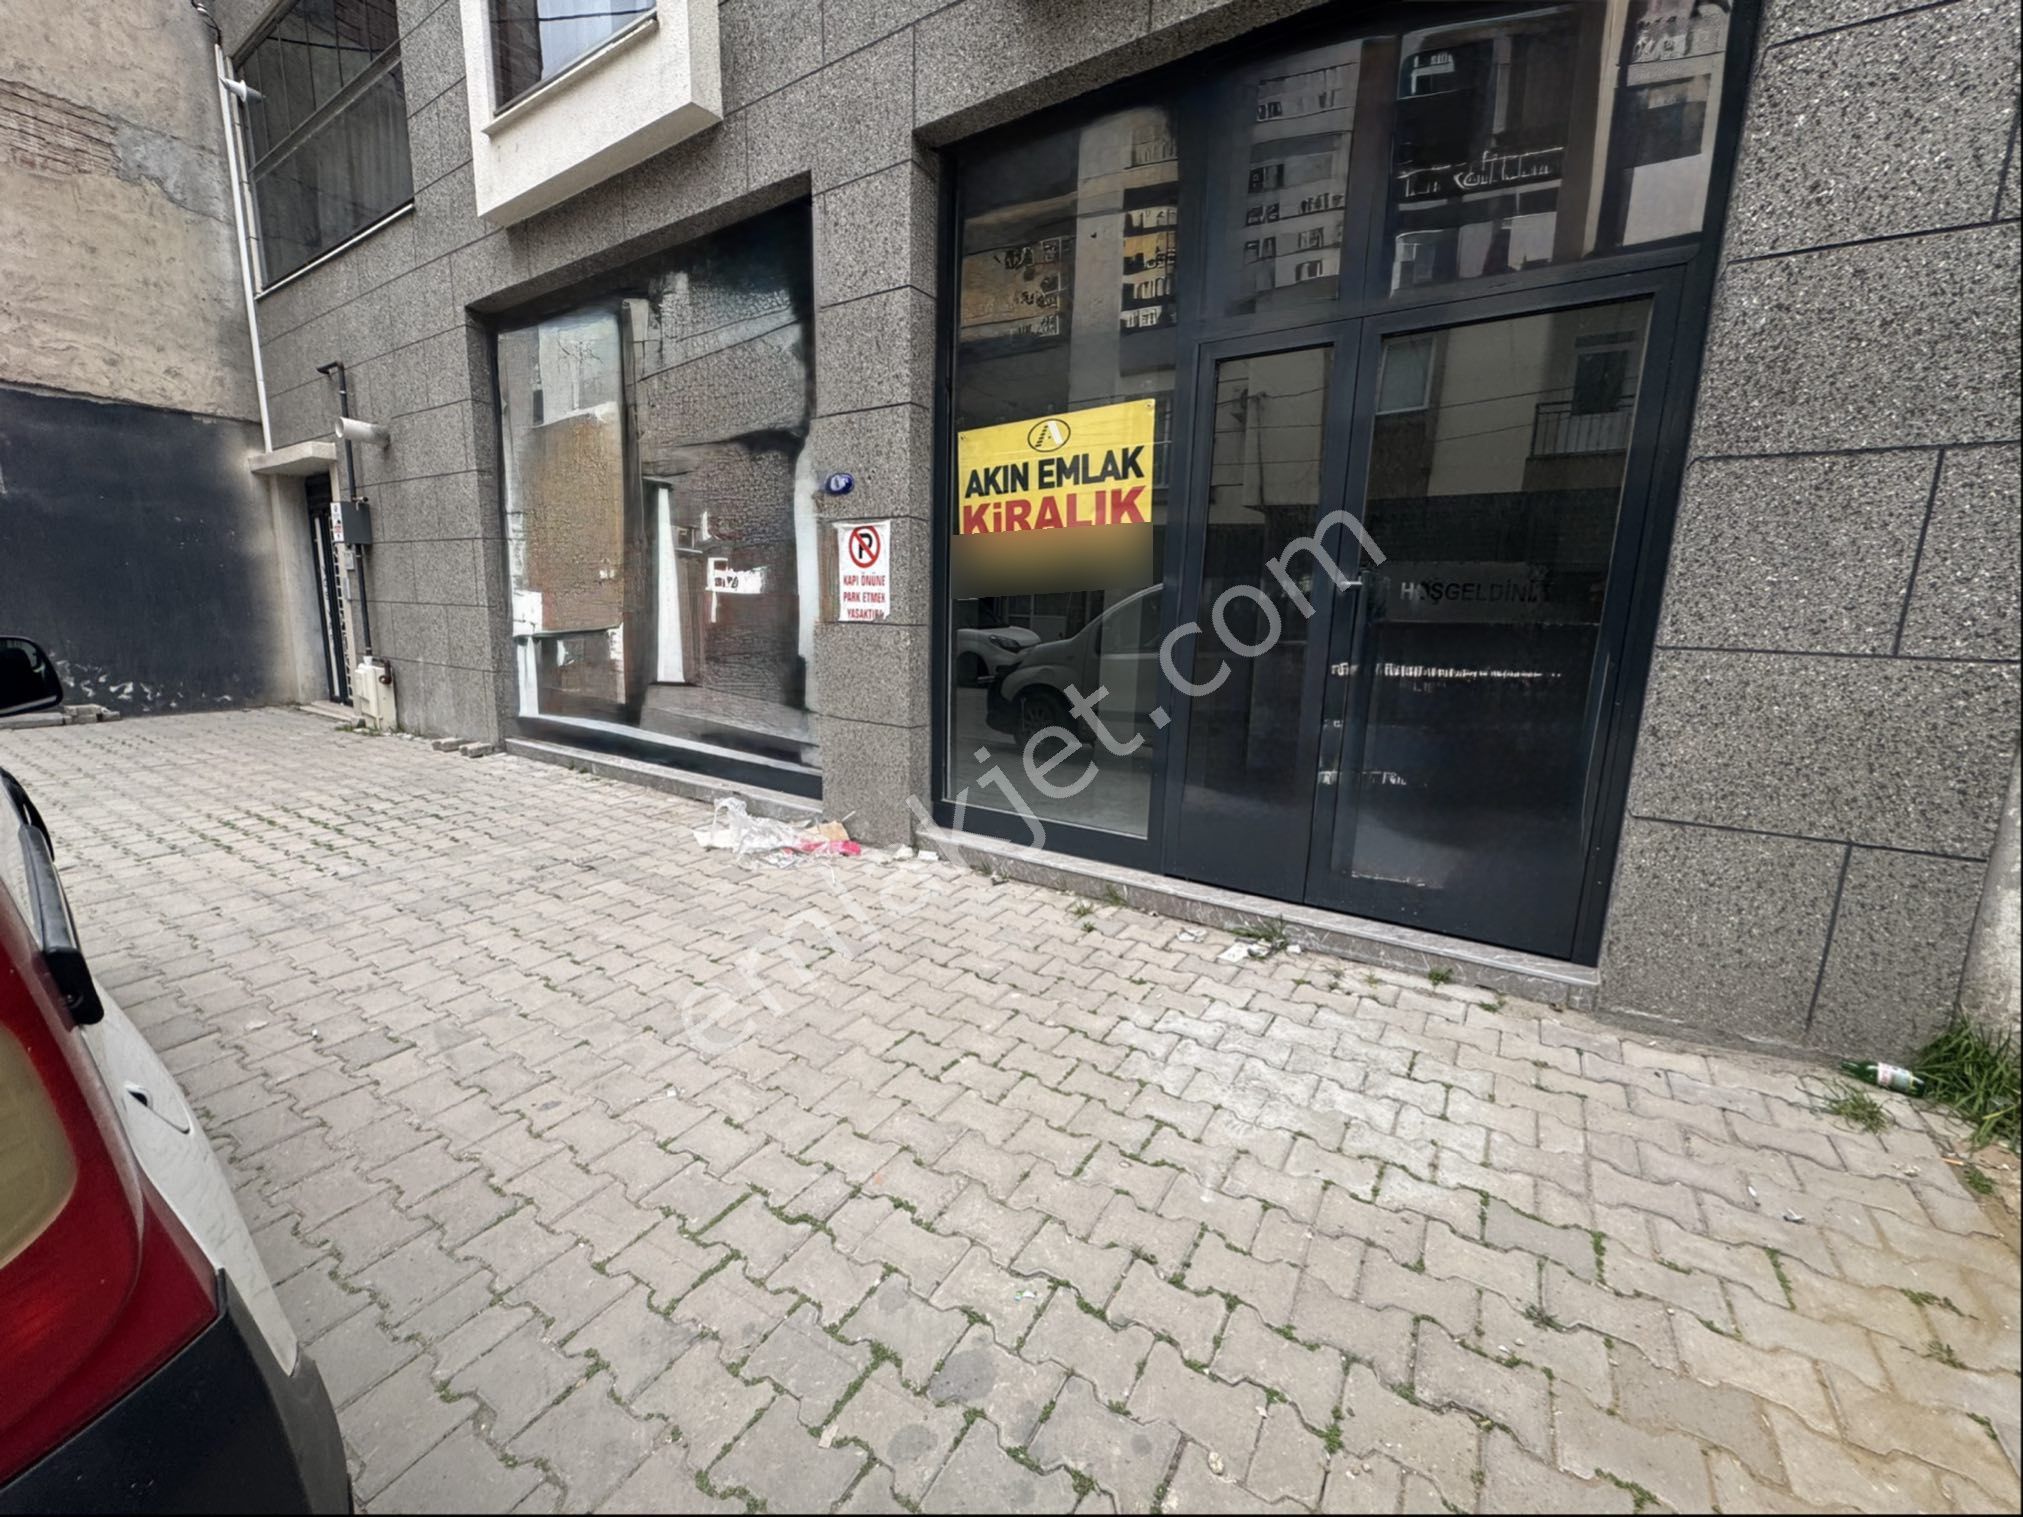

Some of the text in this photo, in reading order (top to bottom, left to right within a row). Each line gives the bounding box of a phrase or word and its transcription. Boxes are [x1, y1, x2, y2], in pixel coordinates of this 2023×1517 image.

[965, 445, 1145, 498] AKIN EMLAK
[843, 572, 885, 586] KAPI ÖNÜNE
[843, 592, 885, 603] PARK ETMEK
